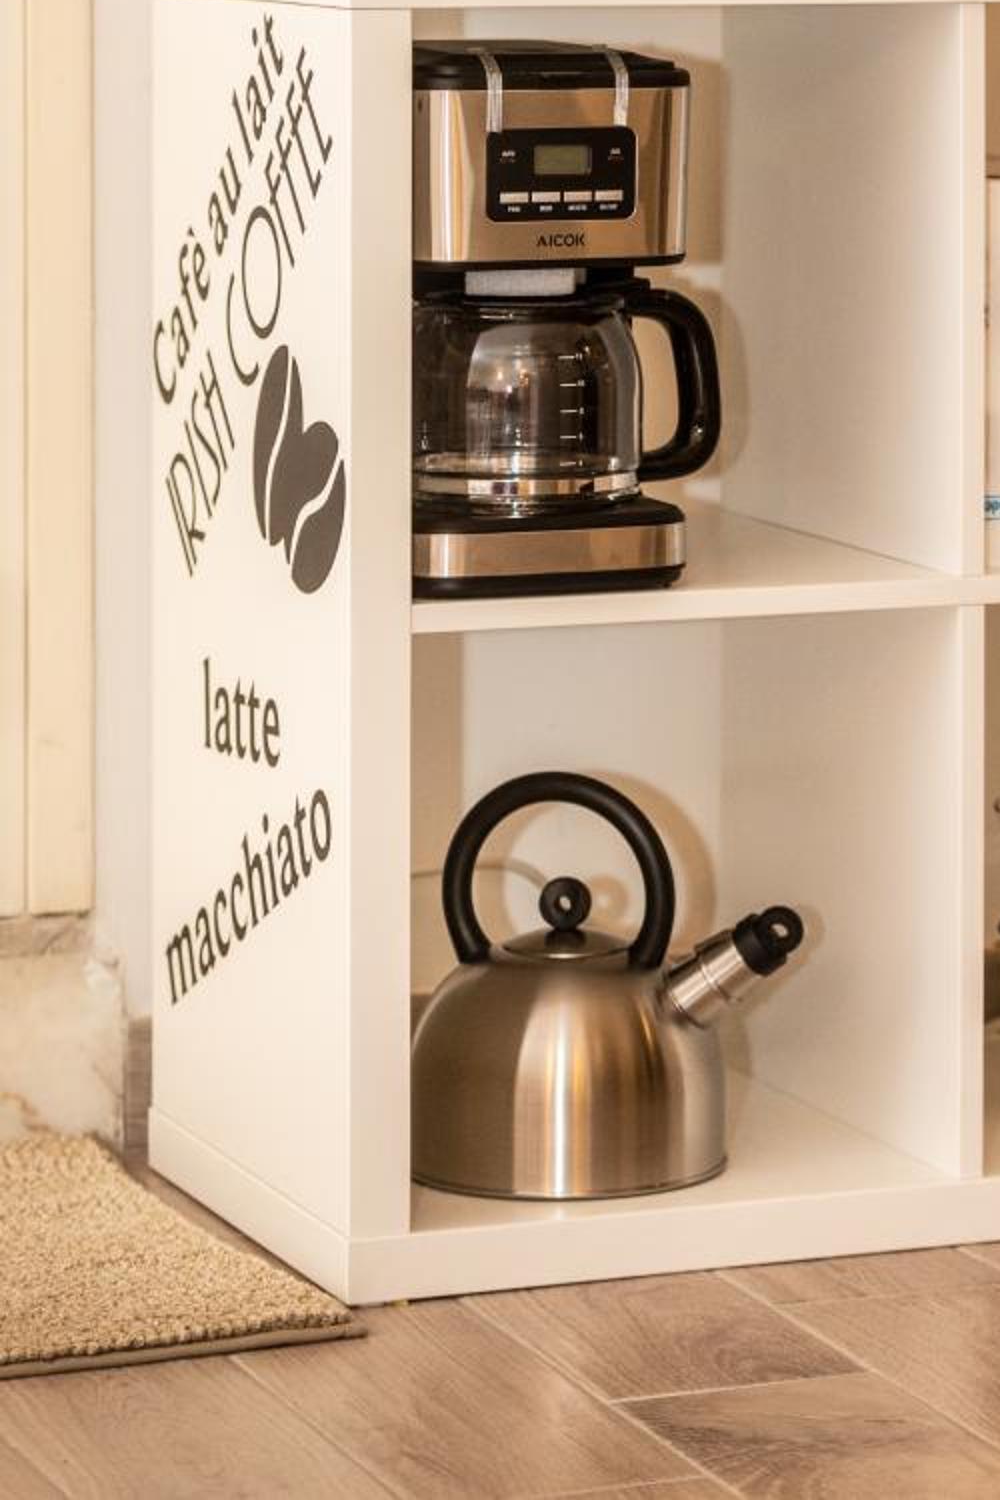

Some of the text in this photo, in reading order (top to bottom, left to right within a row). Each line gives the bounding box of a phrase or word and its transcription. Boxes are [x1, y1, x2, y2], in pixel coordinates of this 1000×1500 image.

[207, 146, 242, 257] au
[232, 12, 284, 164] lait
[535, 233, 586, 248] AICOK
[165, 45, 333, 577] IRISH COFFEE
[203, 655, 282, 768] latte
[164, 788, 333, 1005] macchiato
